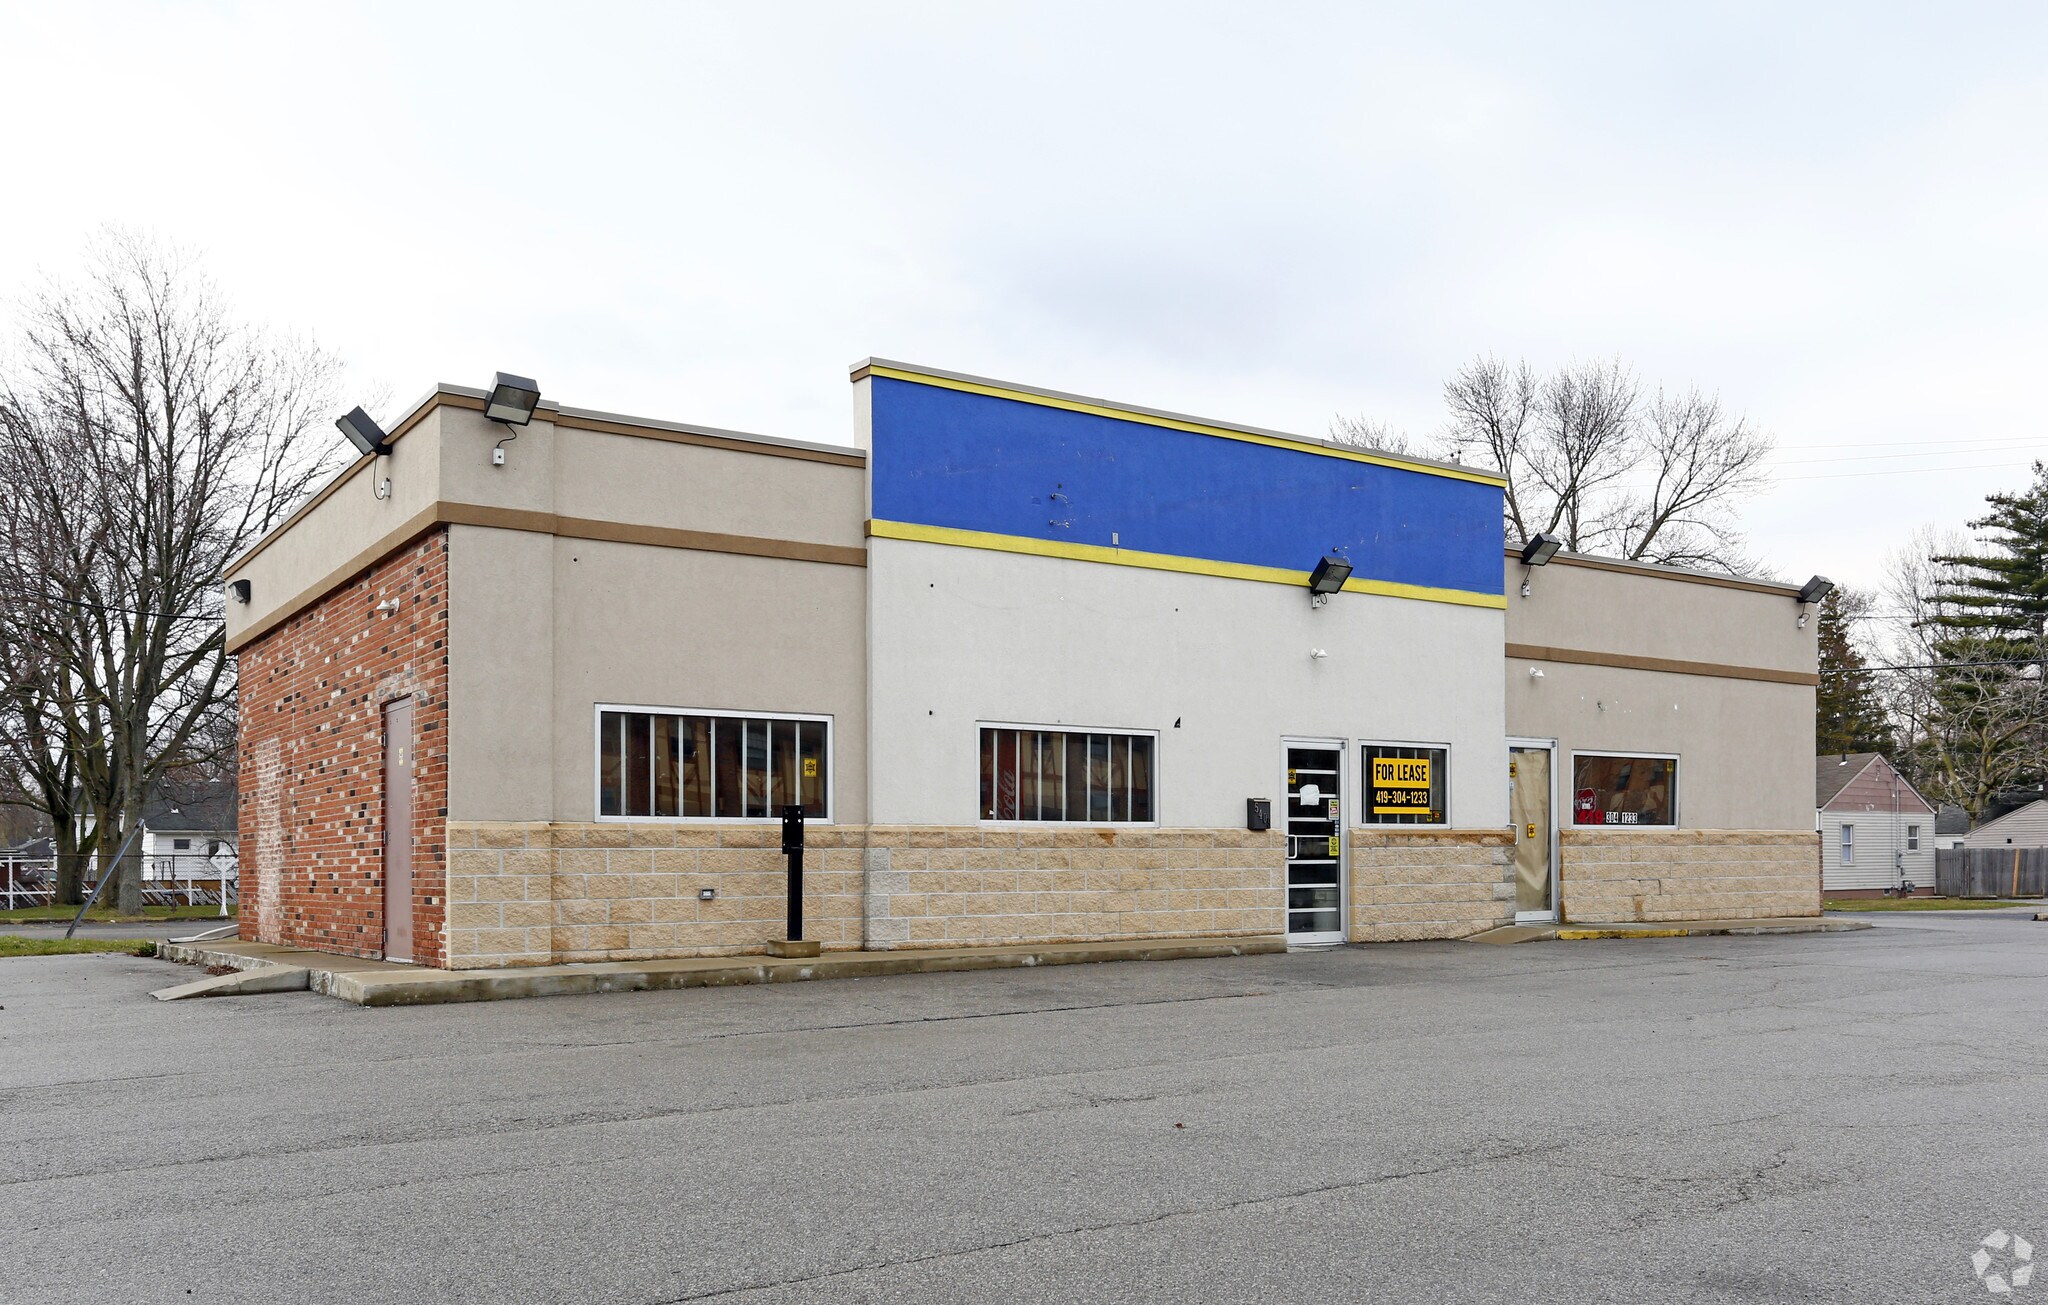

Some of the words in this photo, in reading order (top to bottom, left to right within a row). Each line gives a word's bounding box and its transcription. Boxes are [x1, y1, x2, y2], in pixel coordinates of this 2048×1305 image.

[1375, 763, 1394, 781] FOR
[1397, 764, 1427, 782] LEASE
[1375, 790, 1428, 804] 419-304-1233
[1577, 808, 1604, 824] 419
[1606, 812, 1619, 823] 304
[1621, 812, 1638, 823] 1233
